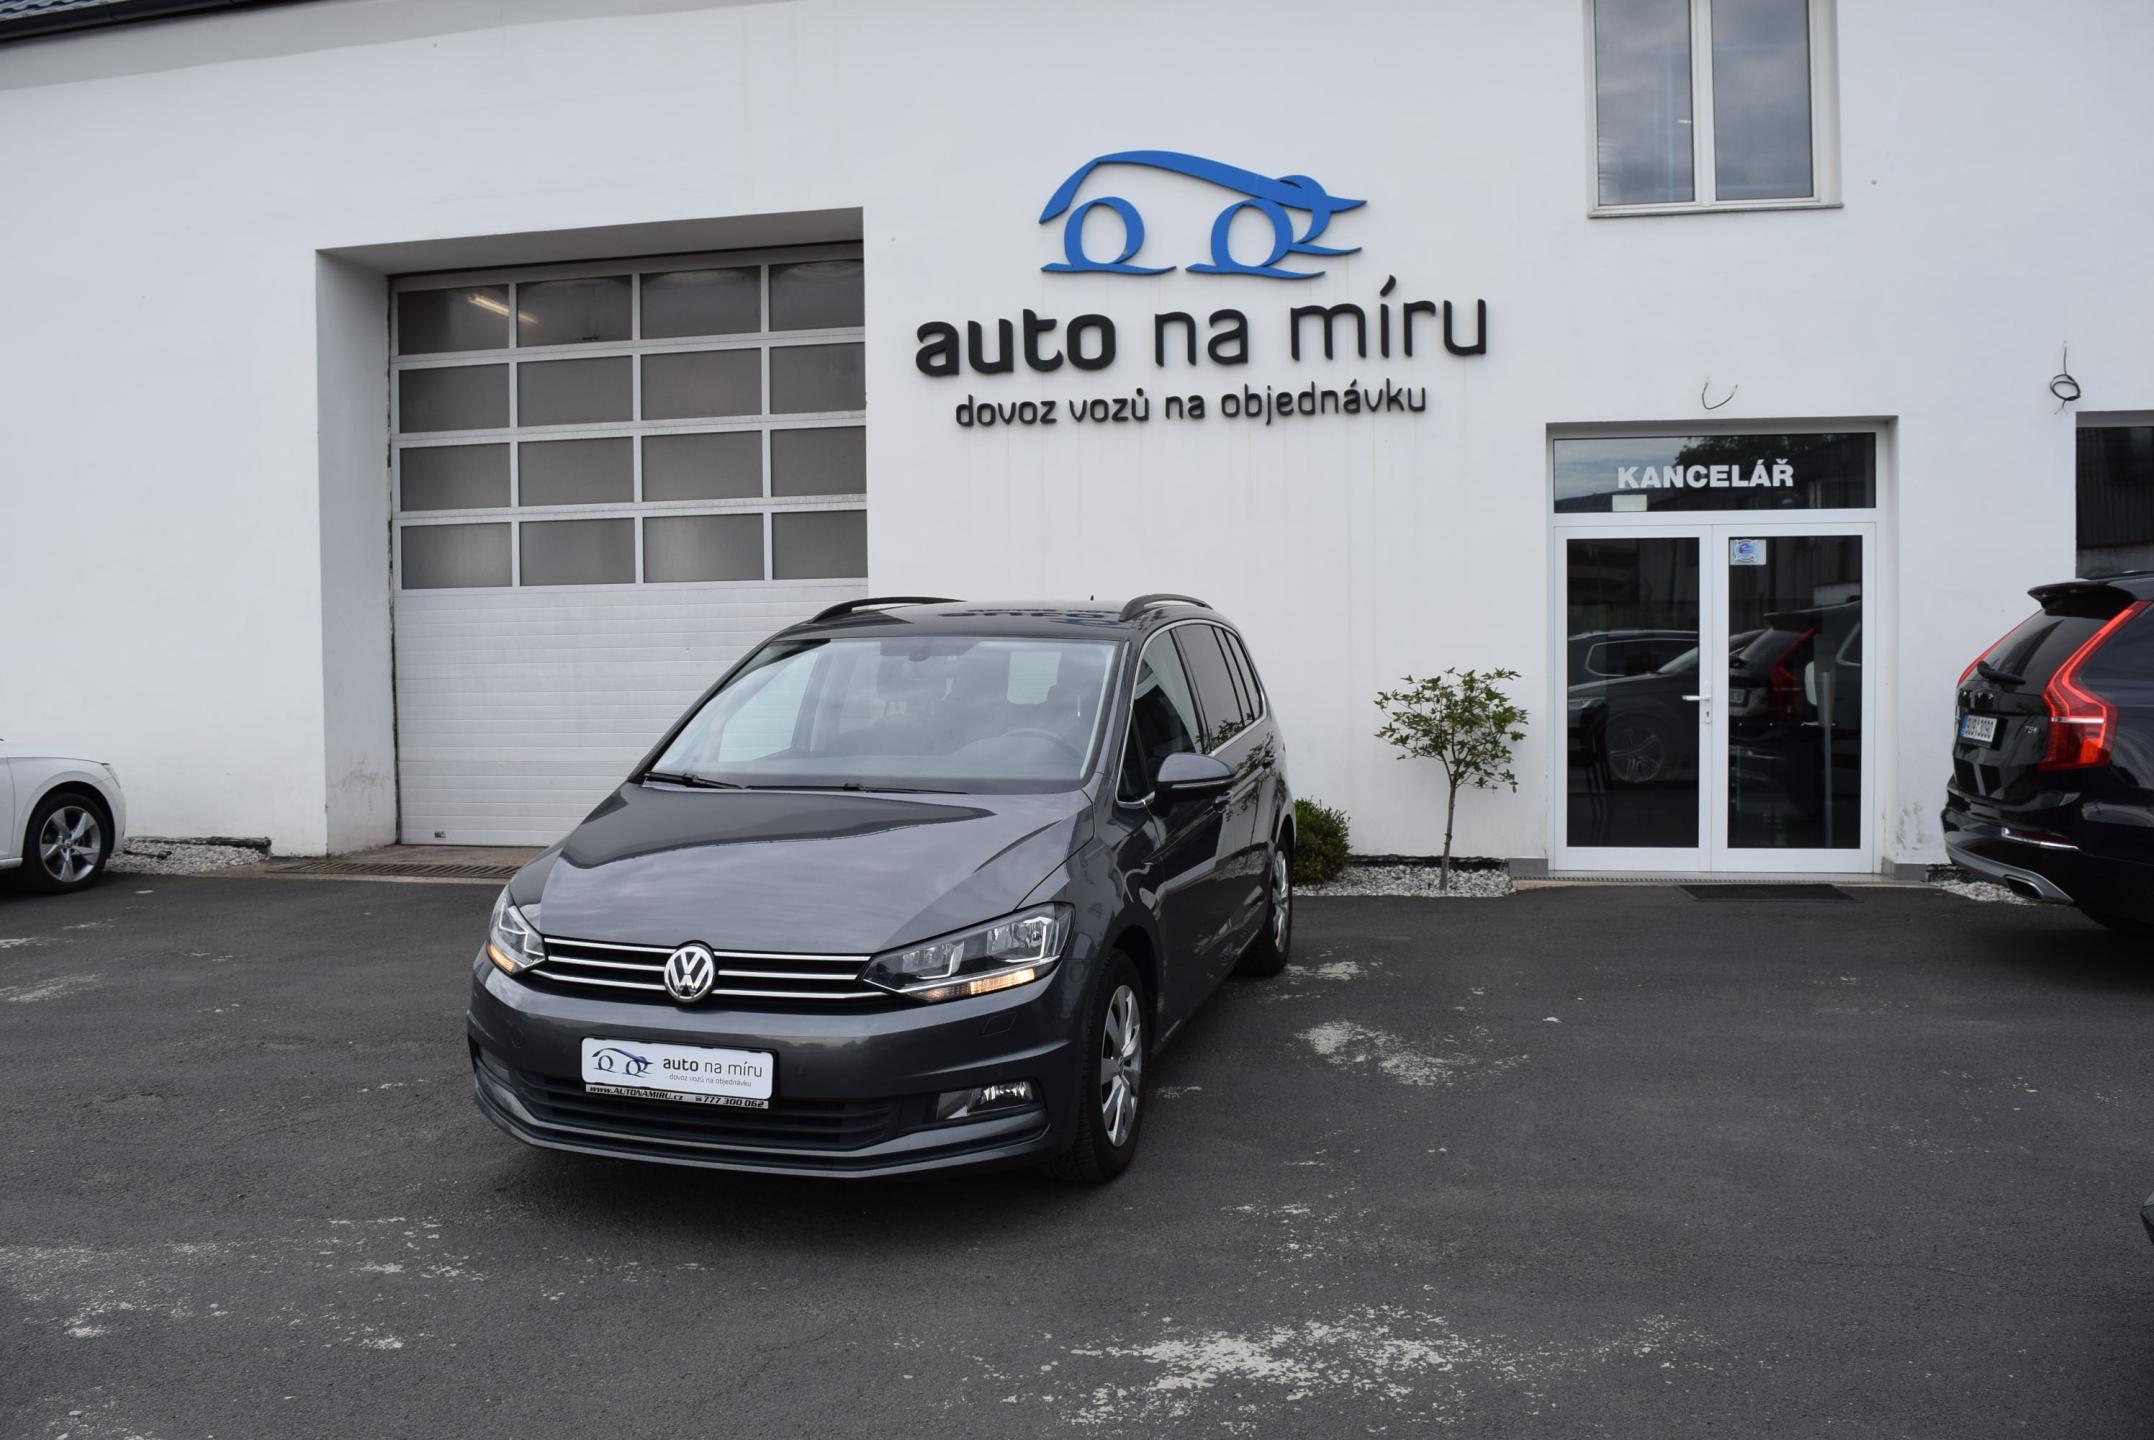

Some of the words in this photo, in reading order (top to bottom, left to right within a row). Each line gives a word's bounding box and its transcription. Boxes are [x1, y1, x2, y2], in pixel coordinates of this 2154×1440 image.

[915, 308, 1117, 377] auto
[1154, 308, 1249, 367] na
[1290, 274, 1487, 361] míru
[955, 394, 1058, 428] dovoz
[1068, 387, 1150, 422] vozů
[1165, 391, 1206, 419] na
[1220, 378, 1427, 426] objednávku
[1617, 458, 1795, 489] KANCELÁŘ
[662, 1057, 699, 1072] auto
[704, 1062, 722, 1074] na
[728, 1061, 763, 1078] míru
[669, 1073, 688, 1082] dovoz
[704, 1095, 722, 1104] 777
[723, 1097, 743, 1107] 300
[744, 1100, 765, 1109] 062
